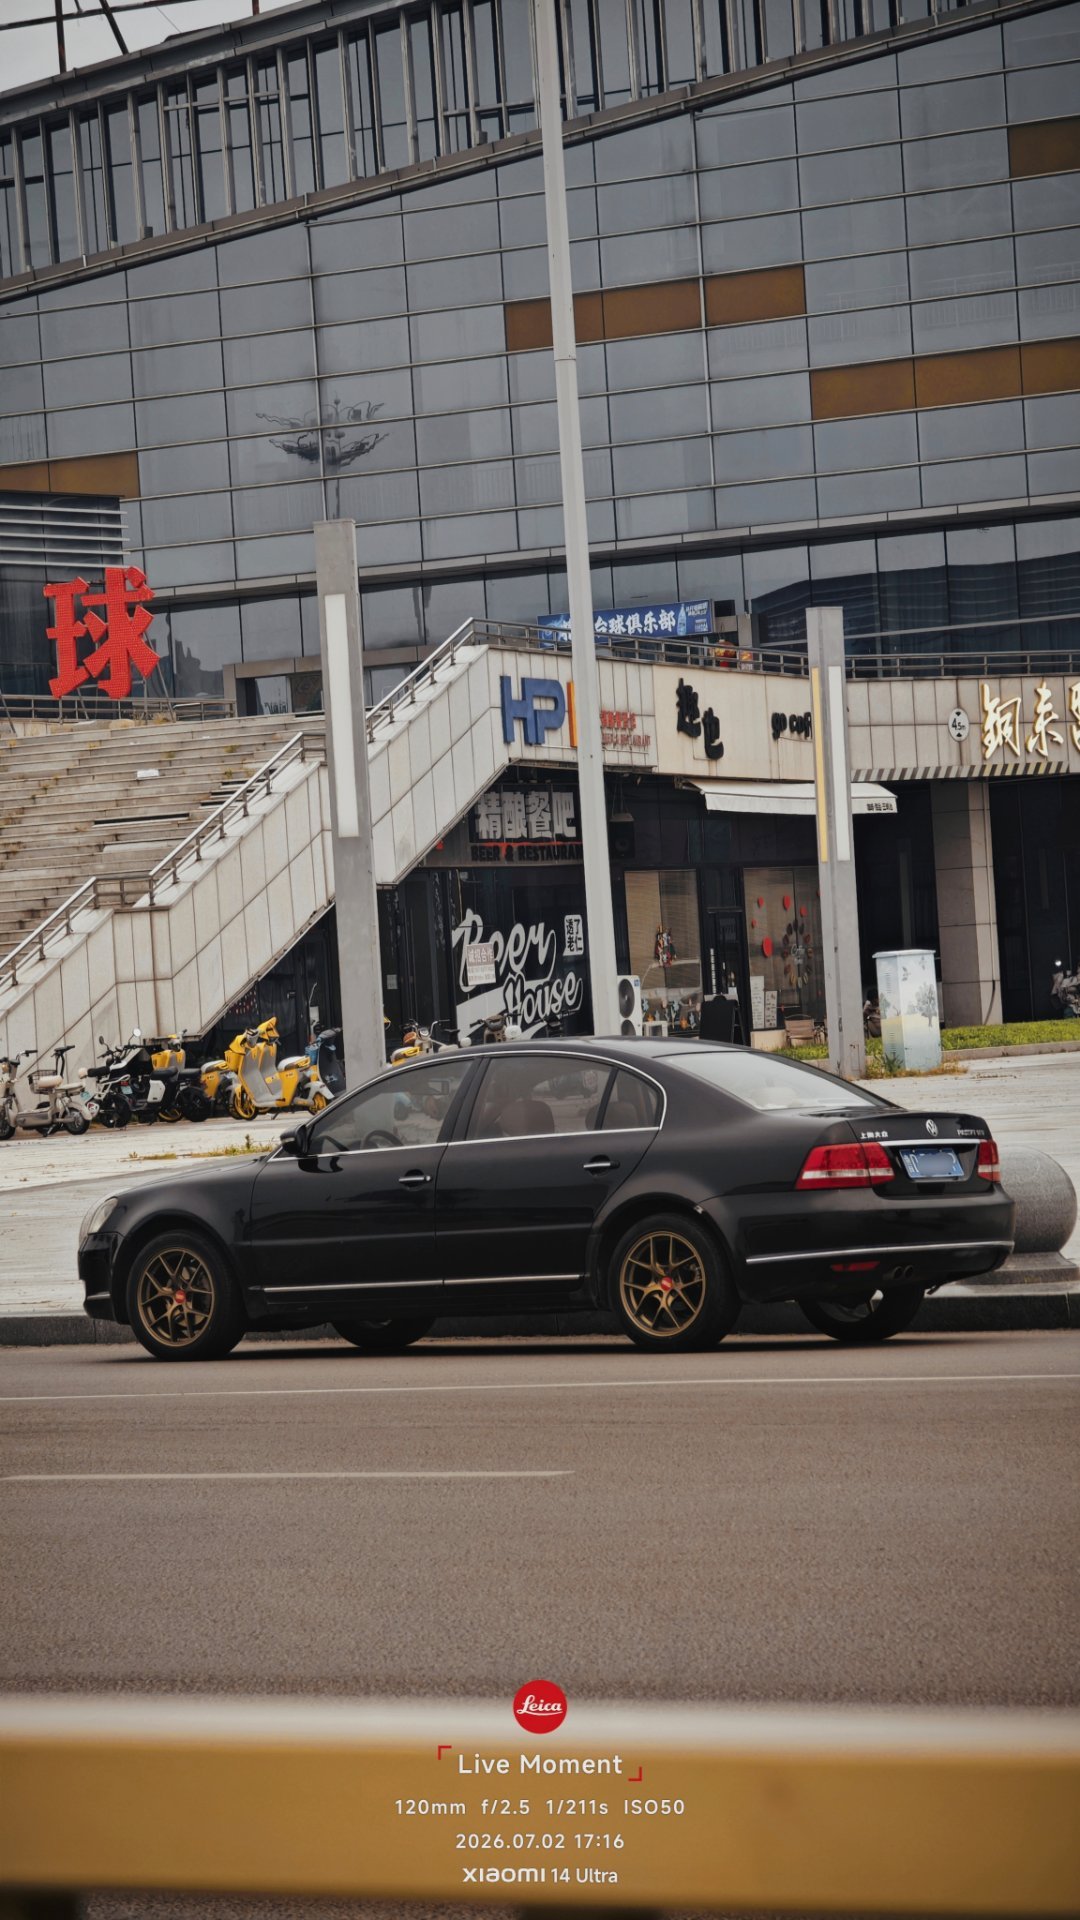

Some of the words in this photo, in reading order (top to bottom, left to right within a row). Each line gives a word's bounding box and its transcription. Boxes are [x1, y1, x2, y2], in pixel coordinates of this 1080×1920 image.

[43, 565, 160, 699] 球
[470, 845, 500, 861] BEER
[518, 845, 583, 862] RESTAURAN
[451, 908, 556, 992] Beer
[503, 971, 584, 1026] House
